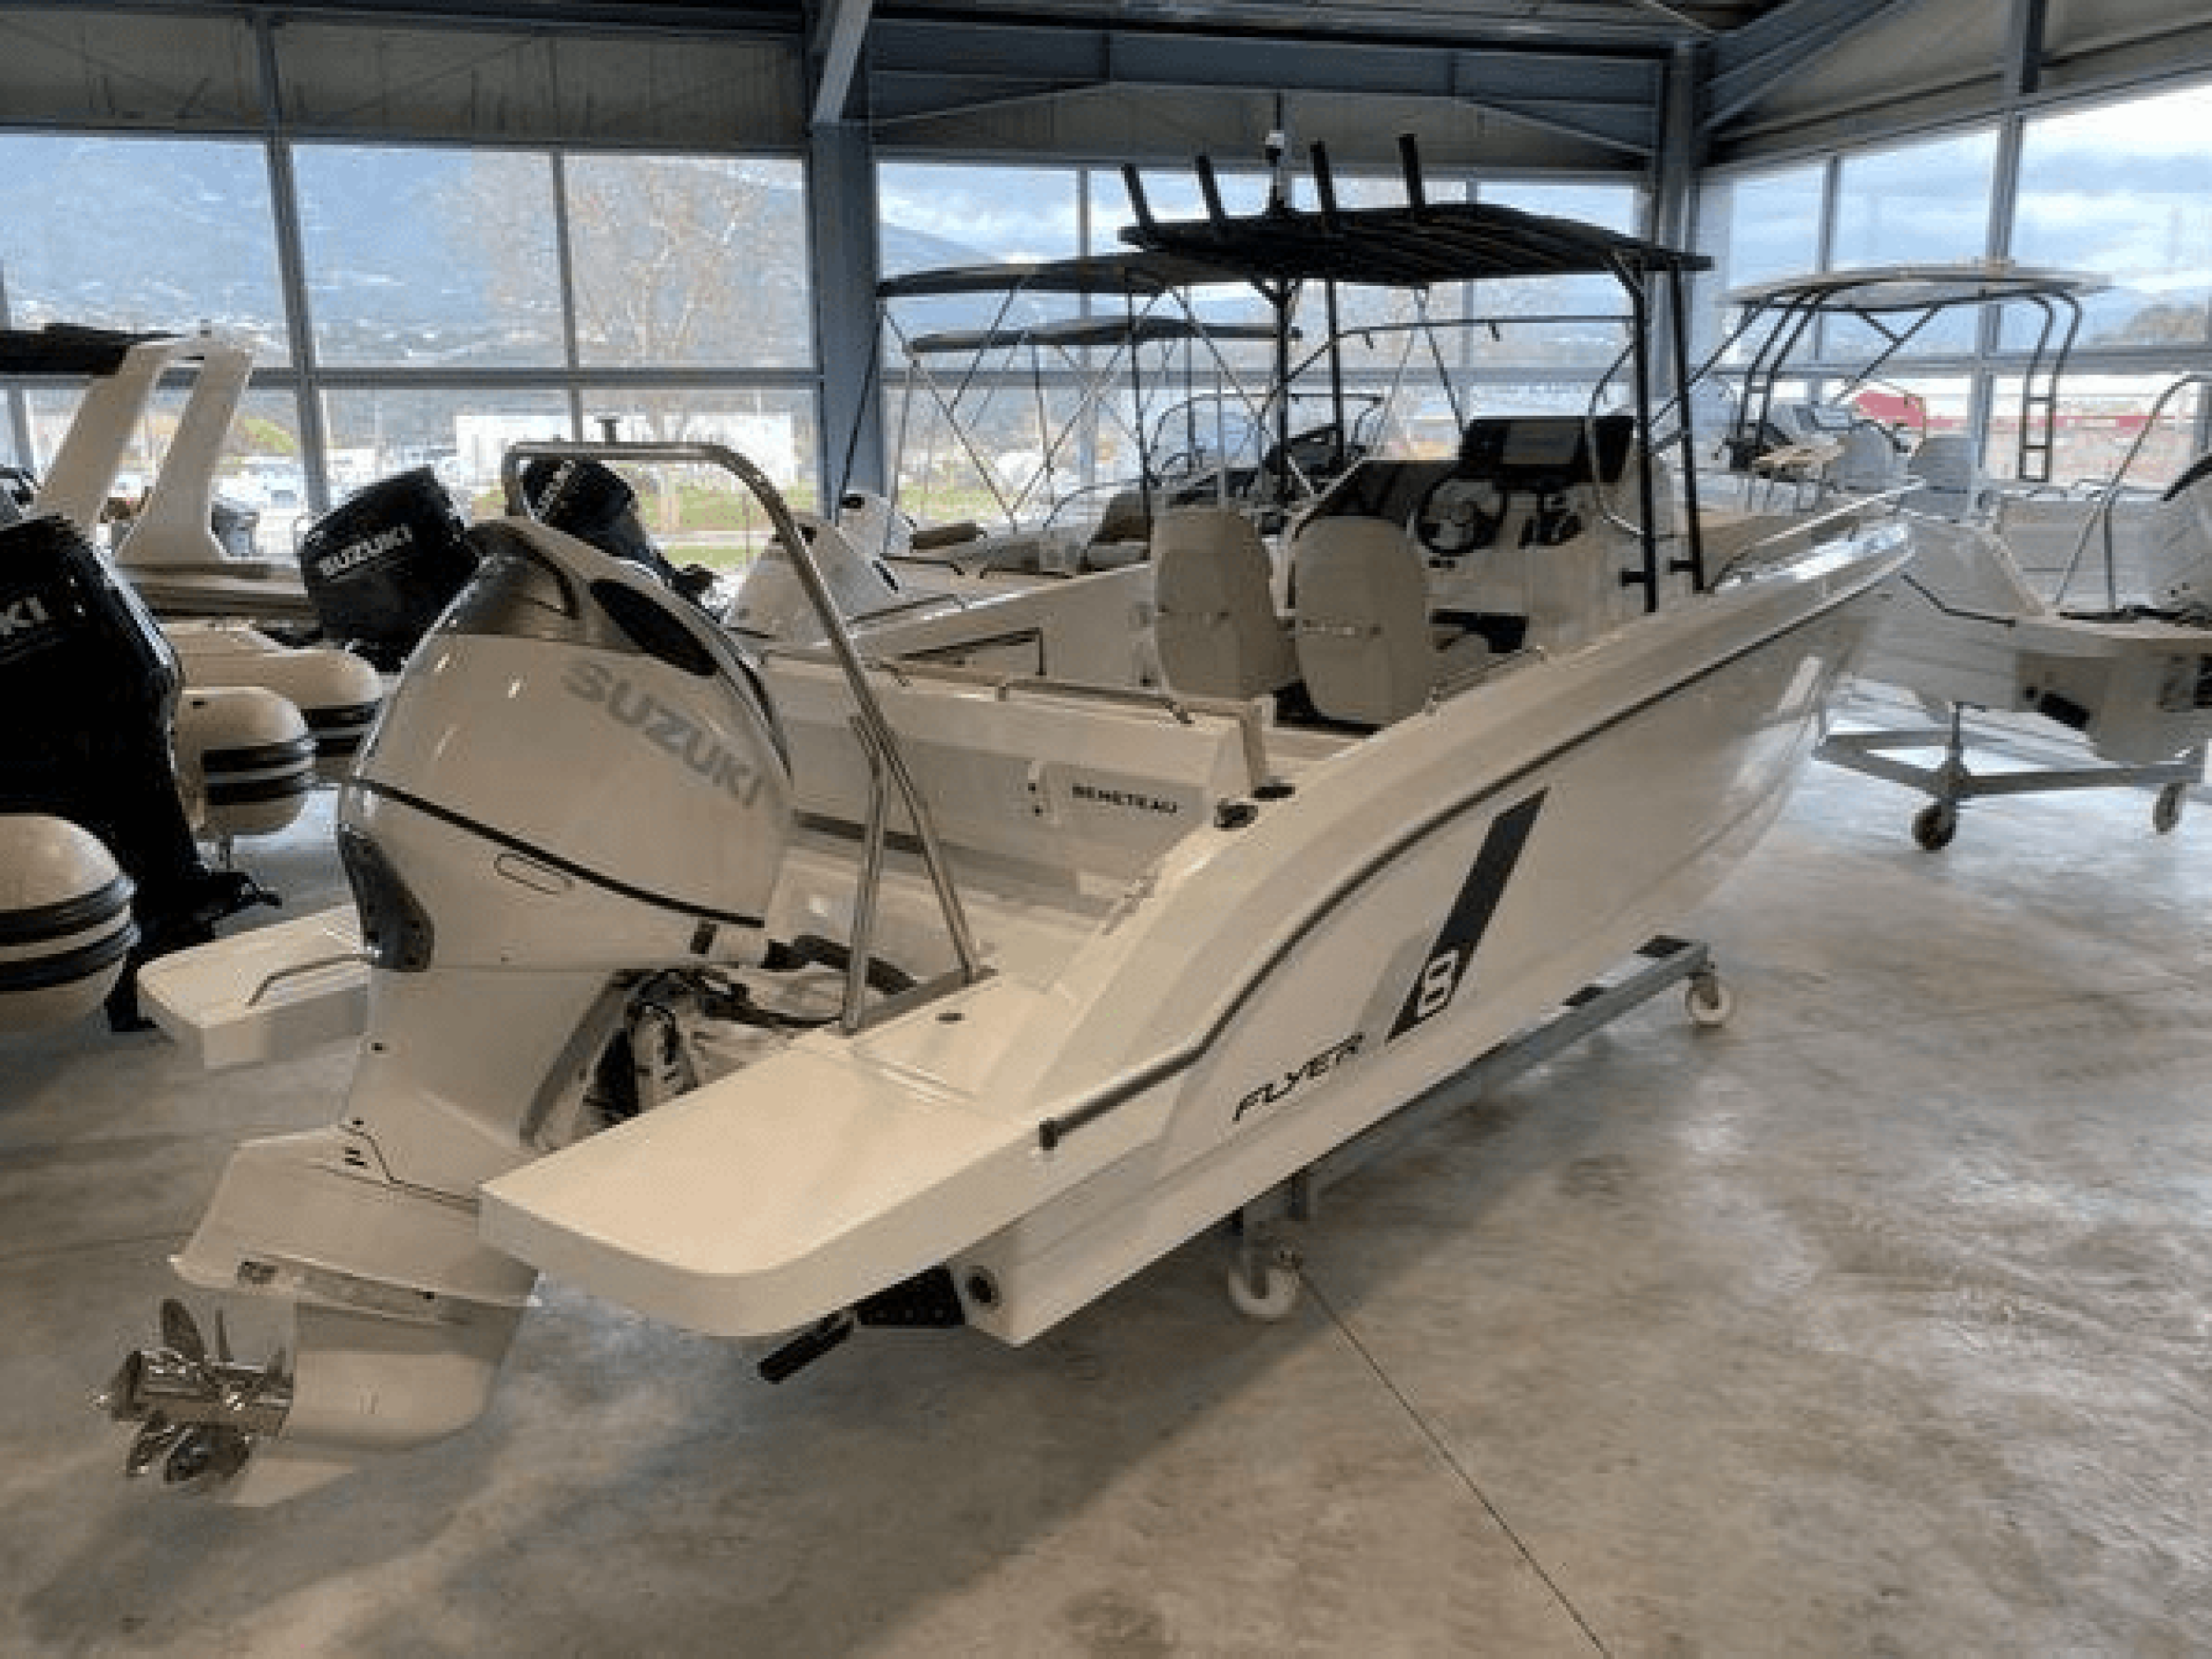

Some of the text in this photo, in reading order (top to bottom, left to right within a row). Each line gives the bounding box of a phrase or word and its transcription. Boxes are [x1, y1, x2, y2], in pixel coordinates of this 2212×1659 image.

[319, 523, 413, 576] SUZUKI
[561, 661, 764, 809] SUZUKI
[1071, 783, 1177, 815] BENETEAU
[1233, 949, 1458, 1124] FLYER 8
